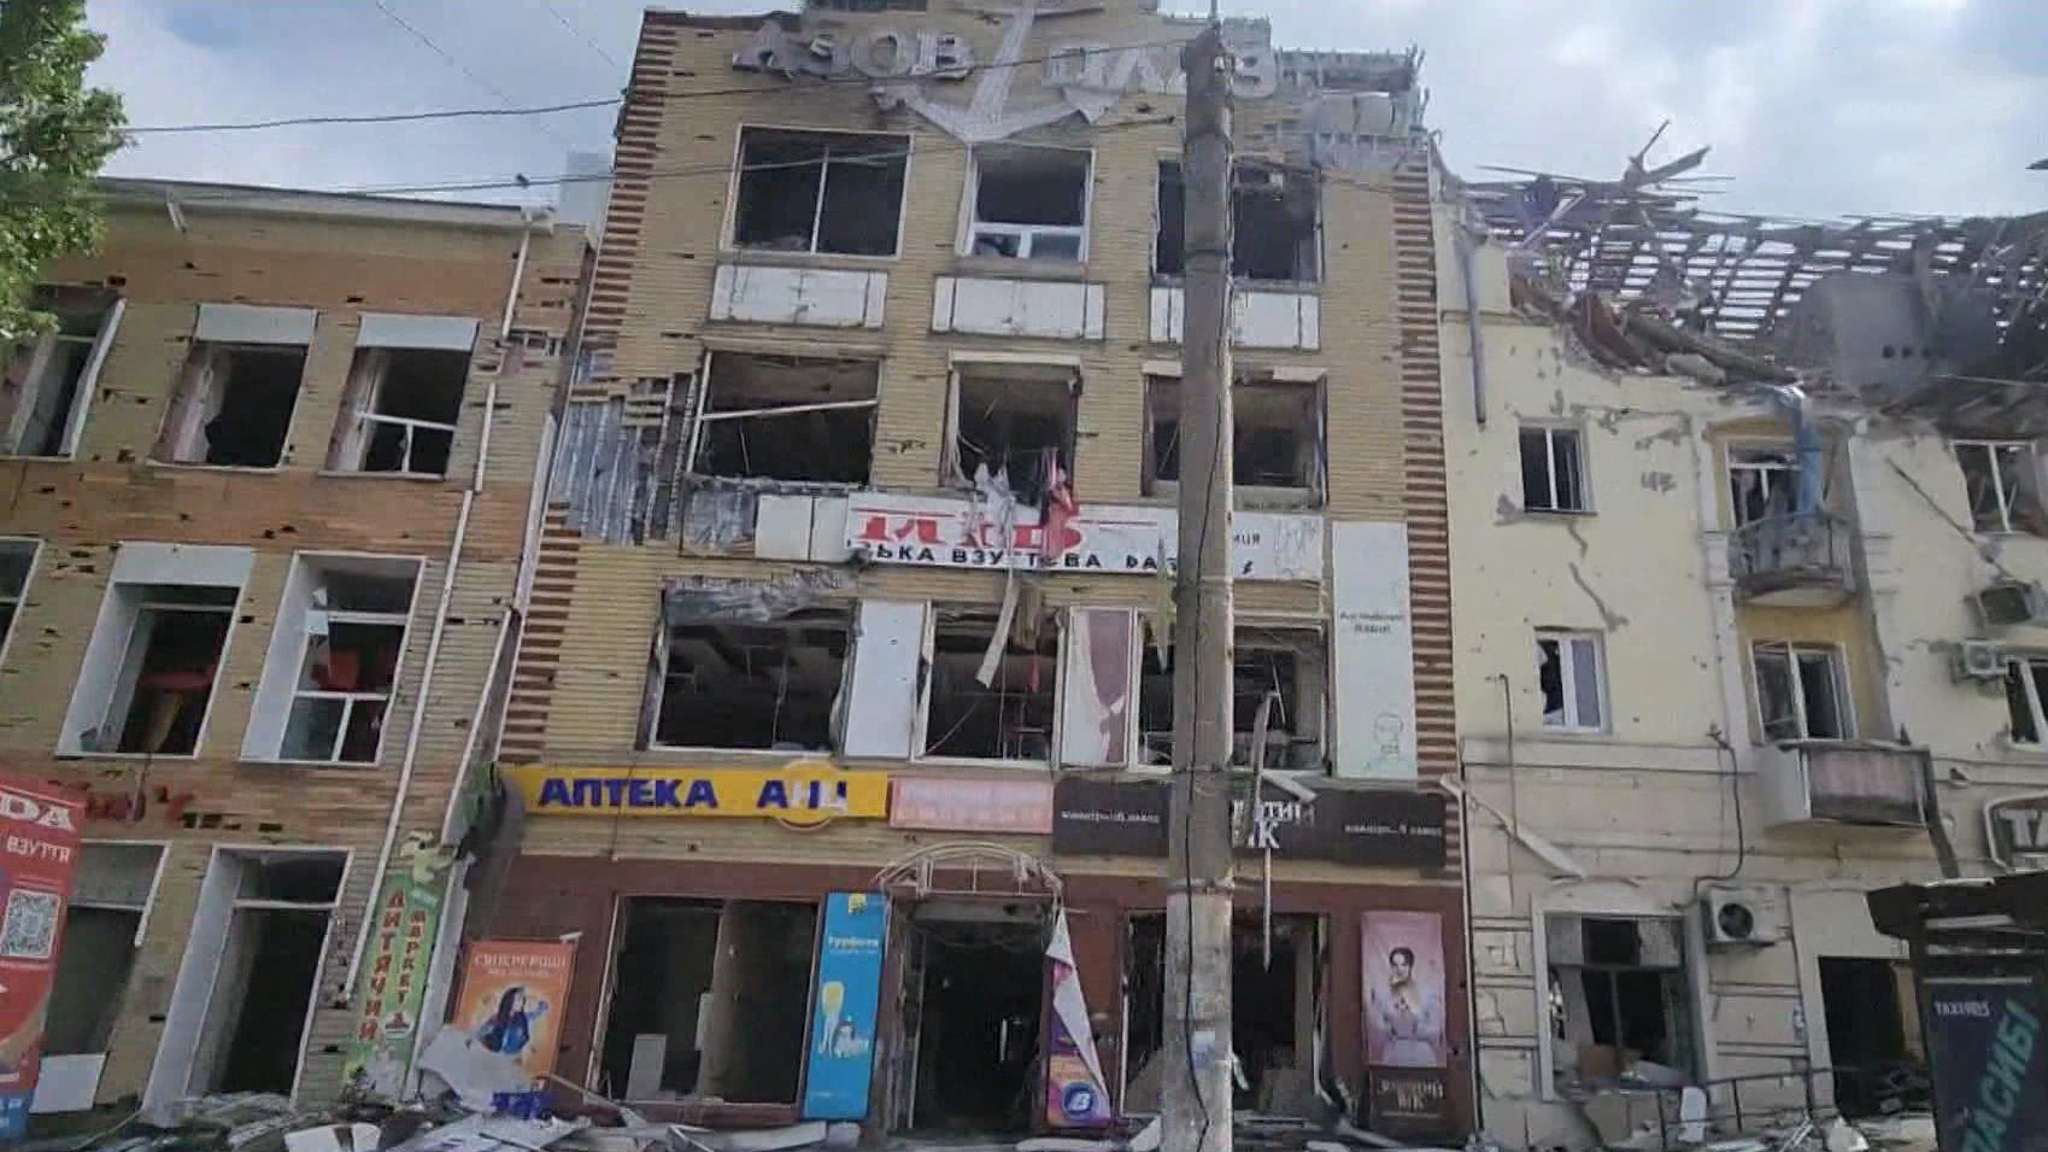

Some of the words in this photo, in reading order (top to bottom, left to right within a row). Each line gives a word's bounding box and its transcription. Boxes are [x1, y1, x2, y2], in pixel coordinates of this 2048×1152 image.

[537, 778, 719, 809] АПТЕКА
[6, 835, 71, 863] ВЗУТТЯ
[359, 888, 406, 1041] ДИТЯЧИЙ
[397, 909, 427, 1005] МАРКЕТ
